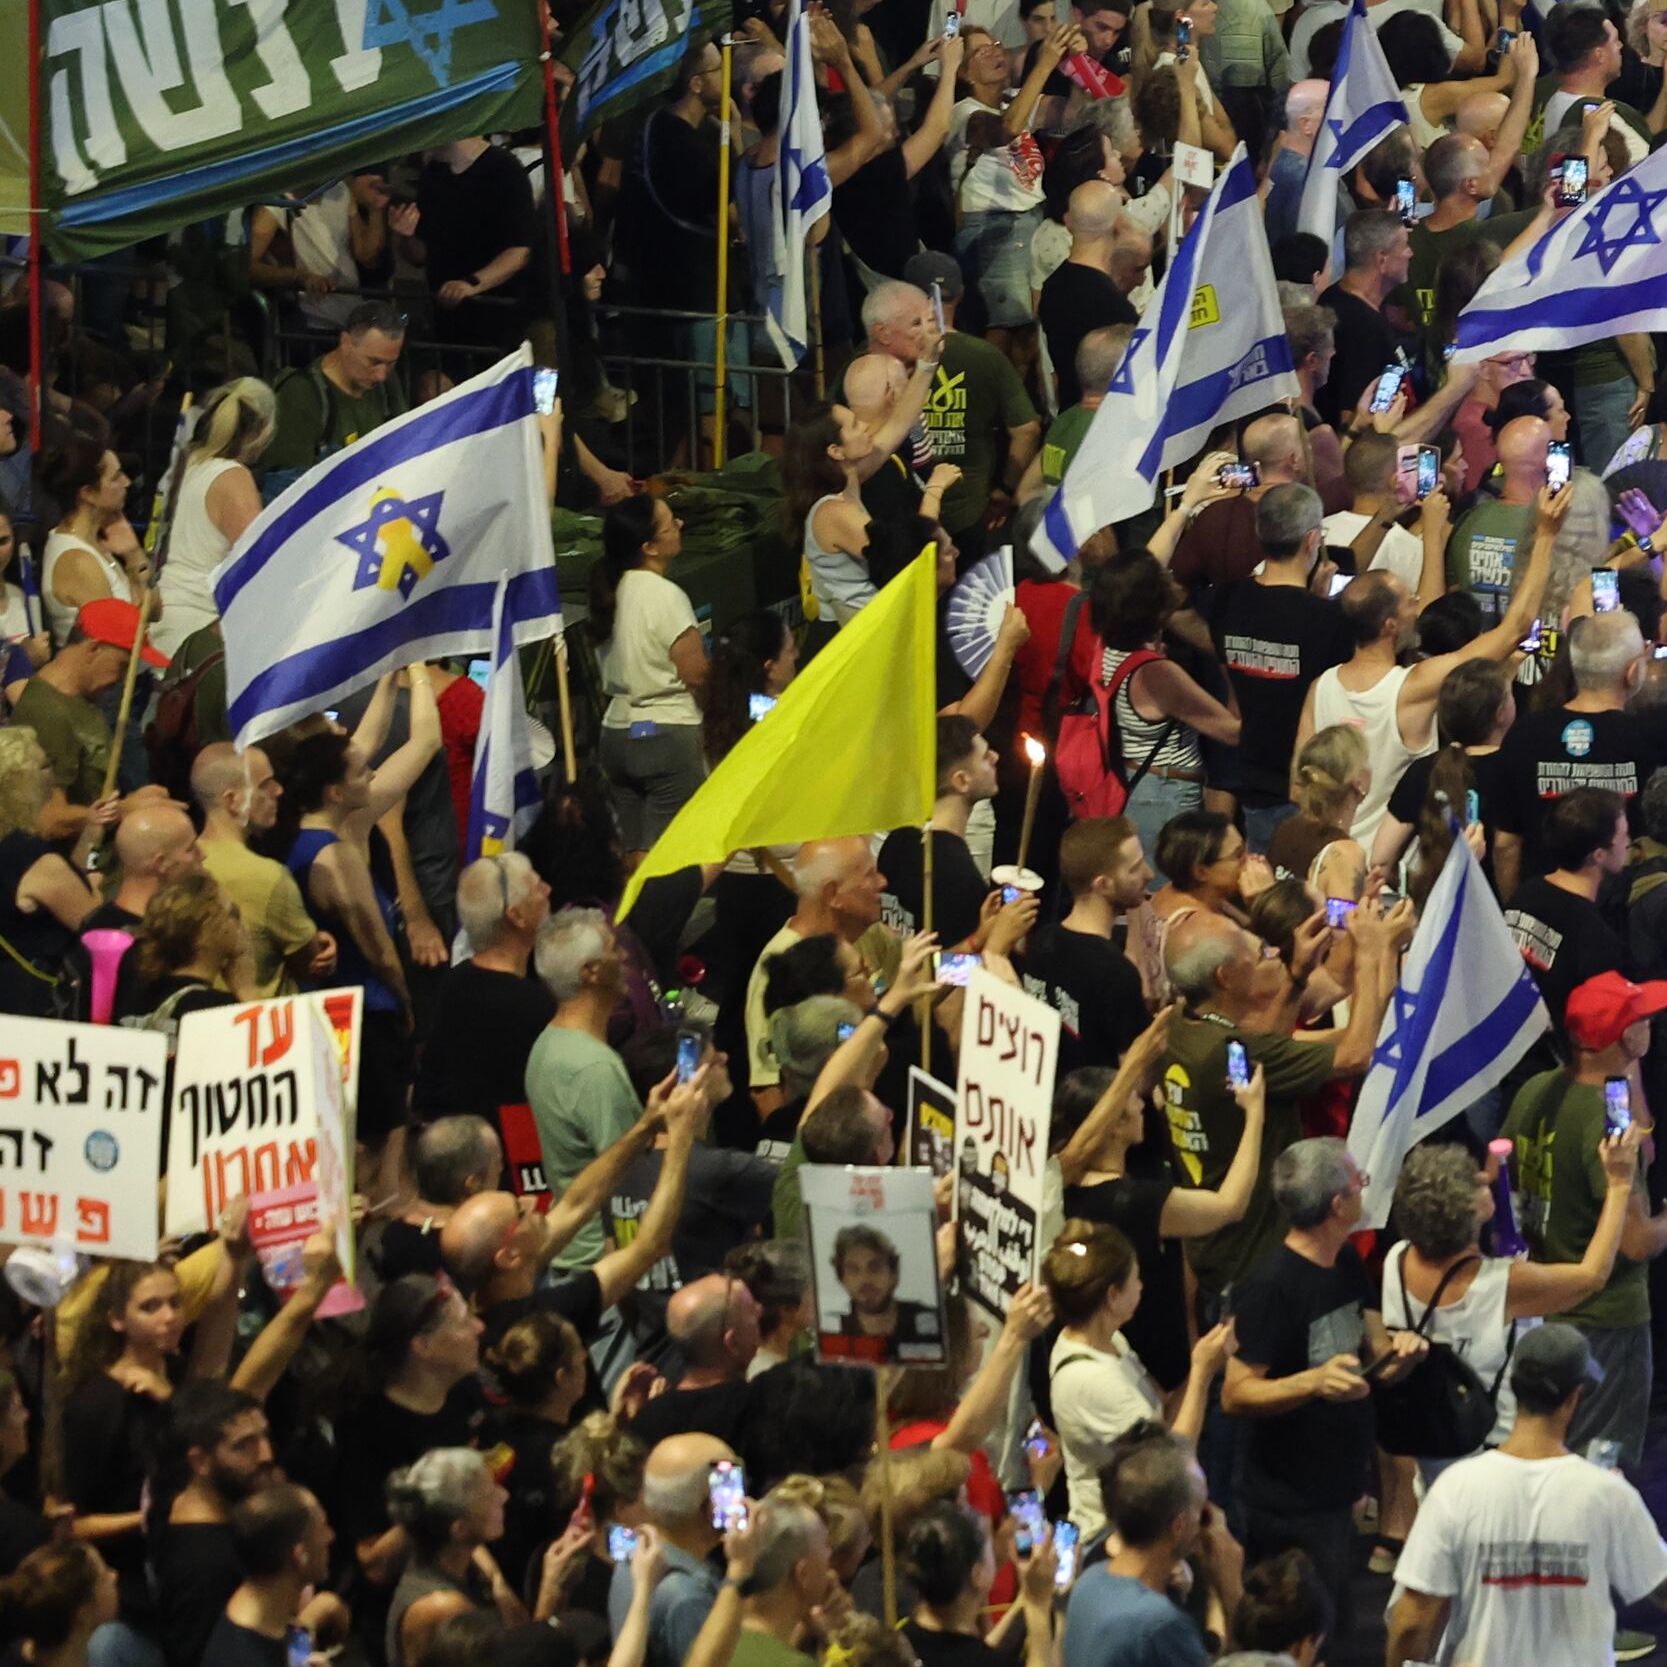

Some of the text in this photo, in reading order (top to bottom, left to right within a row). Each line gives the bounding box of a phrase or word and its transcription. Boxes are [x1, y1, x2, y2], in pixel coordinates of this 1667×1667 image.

[36, 1037, 158, 1112] זה לא
[233, 1002, 292, 1069] עד
[980, 995, 1045, 1086] רוצים
[180, 1070, 297, 1170] החטוף
[966, 1081, 1036, 1177] אותם
[0, 1190, 110, 1244] פש
